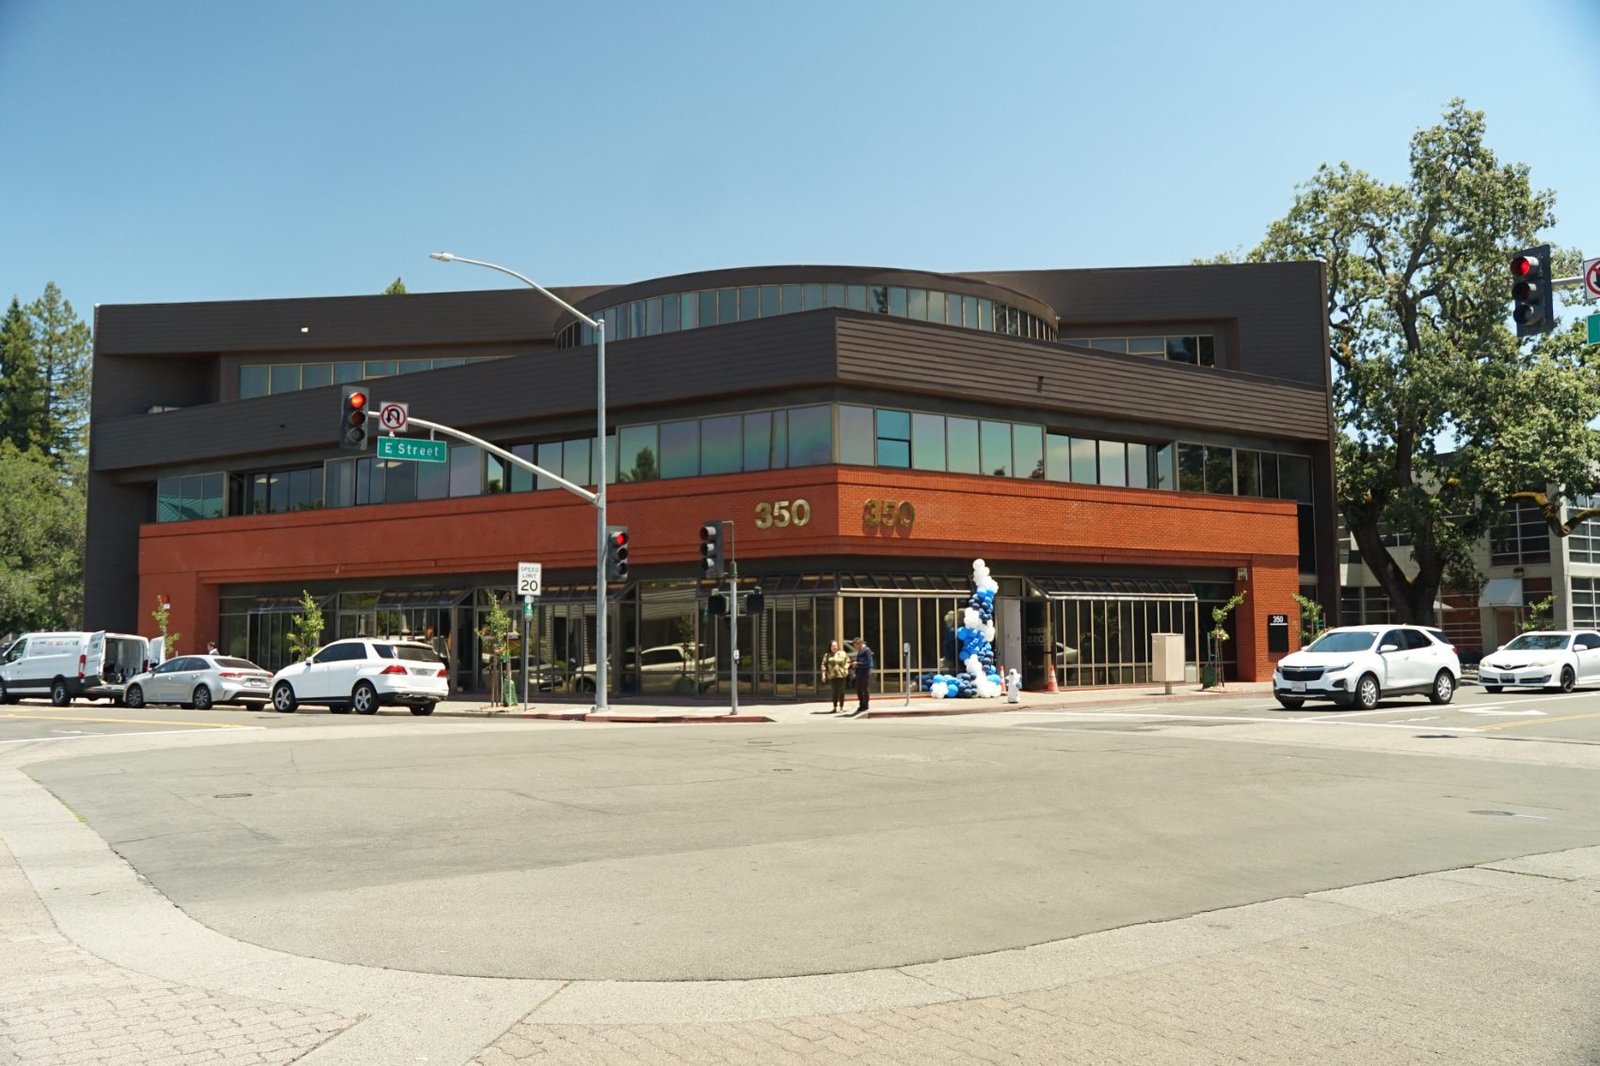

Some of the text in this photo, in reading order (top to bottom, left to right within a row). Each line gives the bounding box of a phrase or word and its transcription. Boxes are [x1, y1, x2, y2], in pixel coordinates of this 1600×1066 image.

[384, 442, 439, 457] E Street
[754, 498, 811, 529] 350
[863, 498, 915, 528] 350
[520, 579, 539, 592] 20
[1272, 615, 1284, 623] 350
